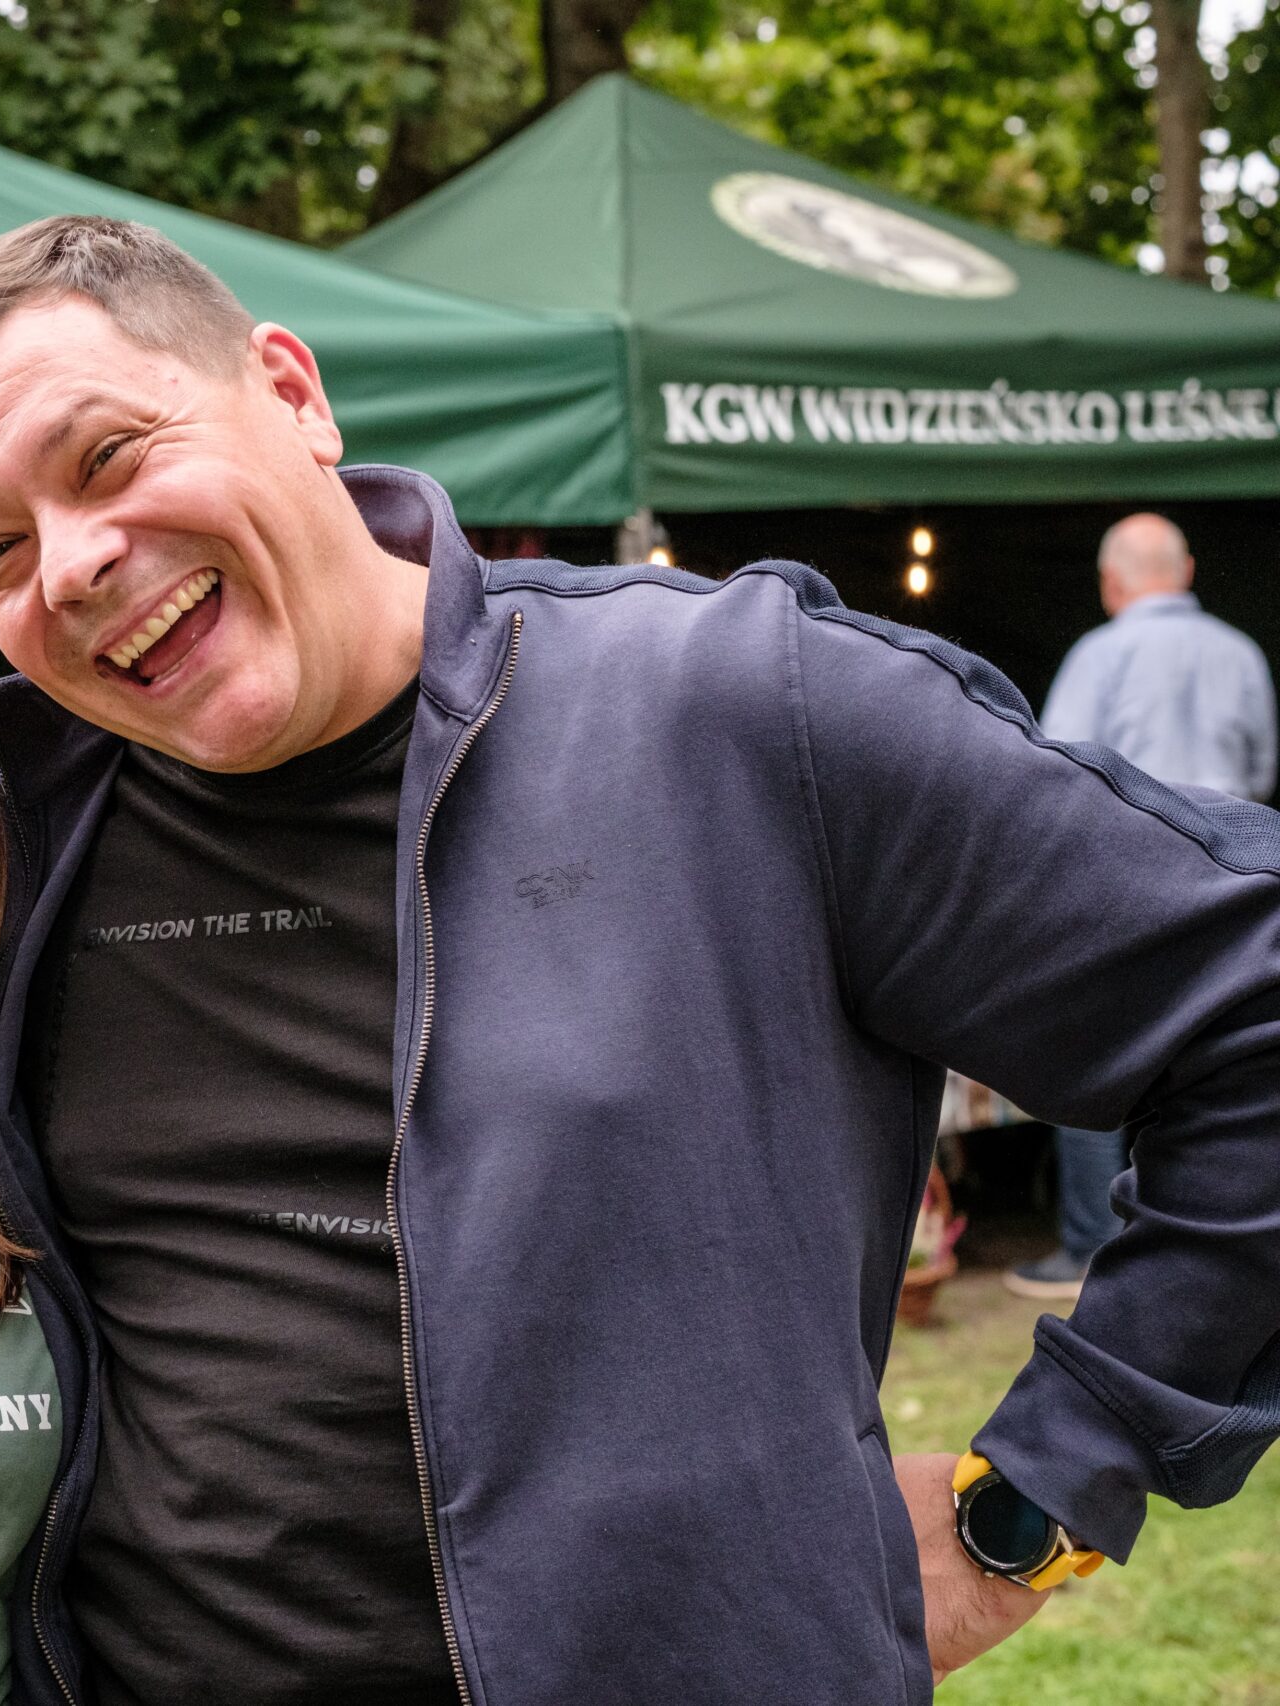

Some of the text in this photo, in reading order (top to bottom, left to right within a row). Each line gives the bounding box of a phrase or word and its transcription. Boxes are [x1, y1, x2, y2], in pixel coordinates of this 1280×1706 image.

[661, 383, 795, 443] KGW
[799, 377, 1118, 444] WIDZIEŃSKO
[86, 906, 333, 945] ENVISION THE TRAIL
